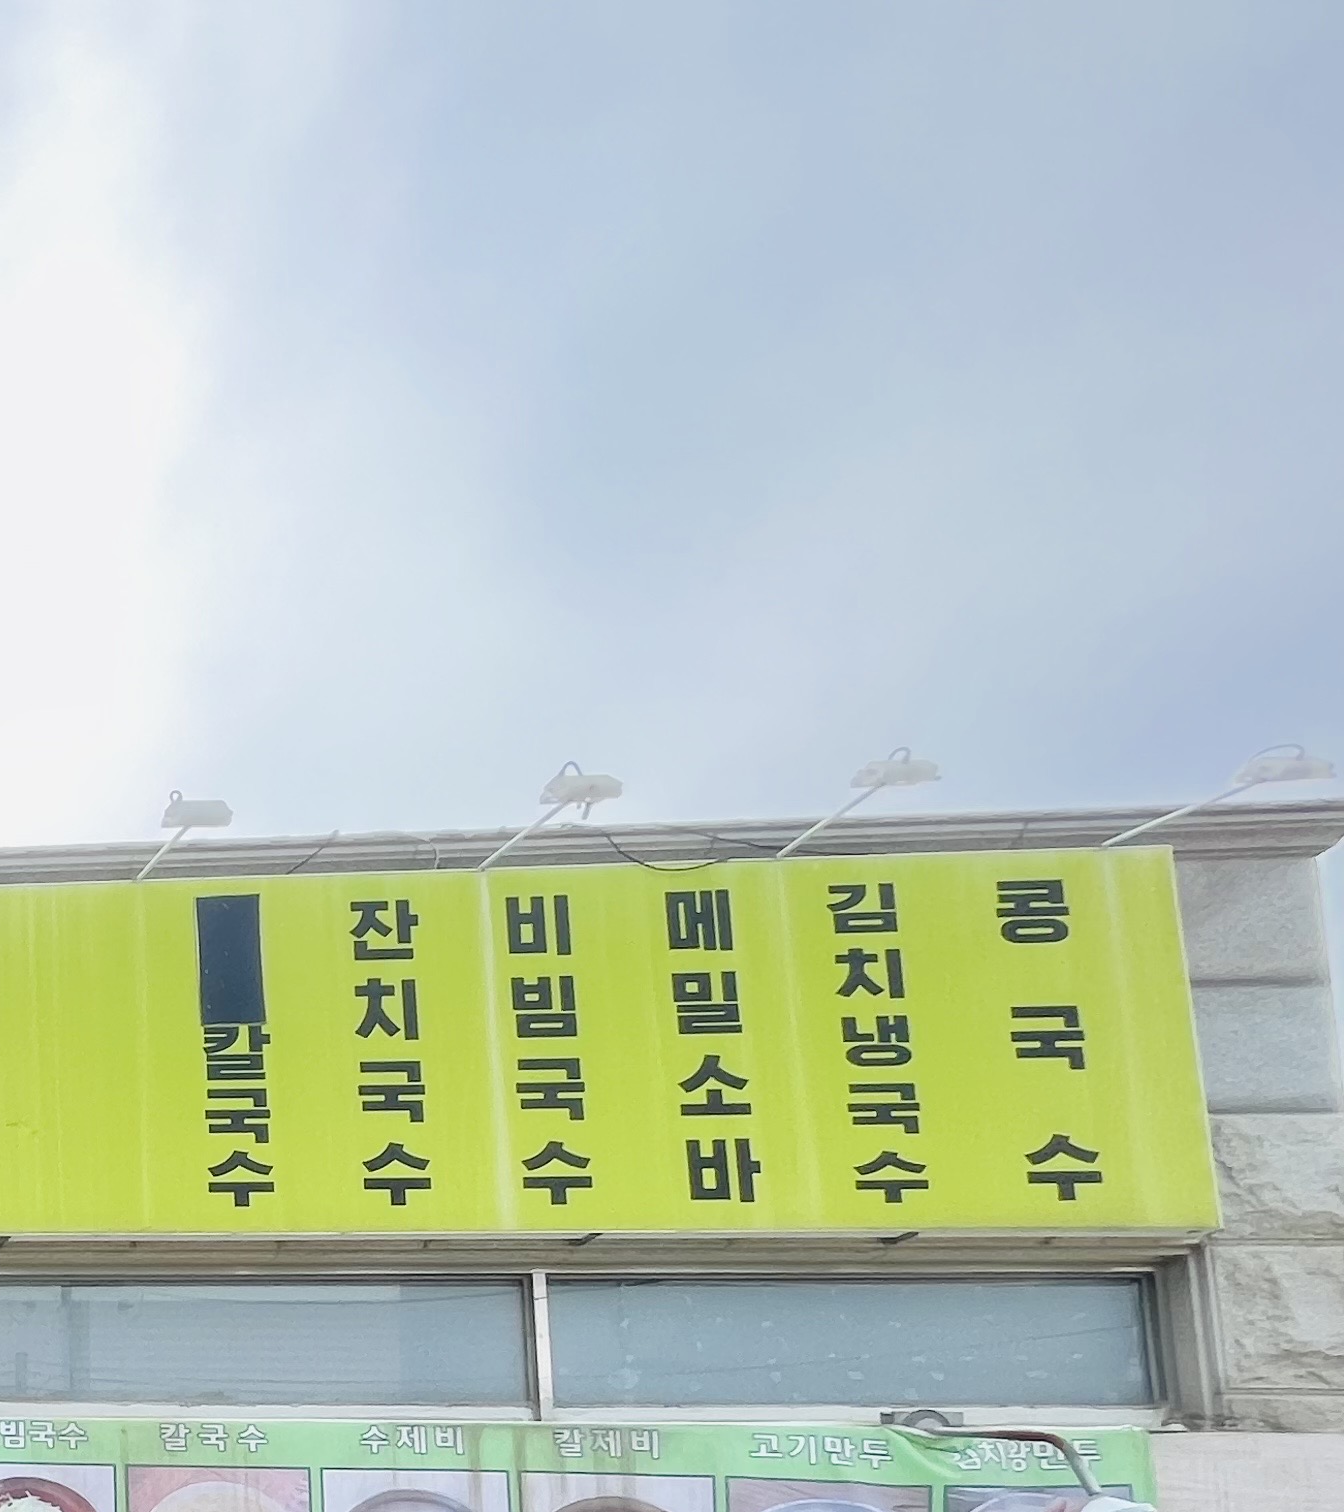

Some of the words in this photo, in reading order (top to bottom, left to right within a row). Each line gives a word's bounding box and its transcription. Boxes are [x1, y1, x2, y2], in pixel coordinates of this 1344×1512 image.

[202, 1026, 275, 1208] 칼국수
[349, 899, 432, 1206] 잔치국수
[505, 894, 593, 1206] 비빔국수
[664, 889, 762, 1203] 메밀소바
[826, 882, 929, 1204] 김치냉국수
[996, 879, 1103, 1202] 콩국수
[159, 1423, 269, 1452] 칼국수
[360, 1424, 465, 1455] 수제비
[553, 1428, 660, 1459] 칼제비
[749, 1433, 893, 1469] 고기만두
